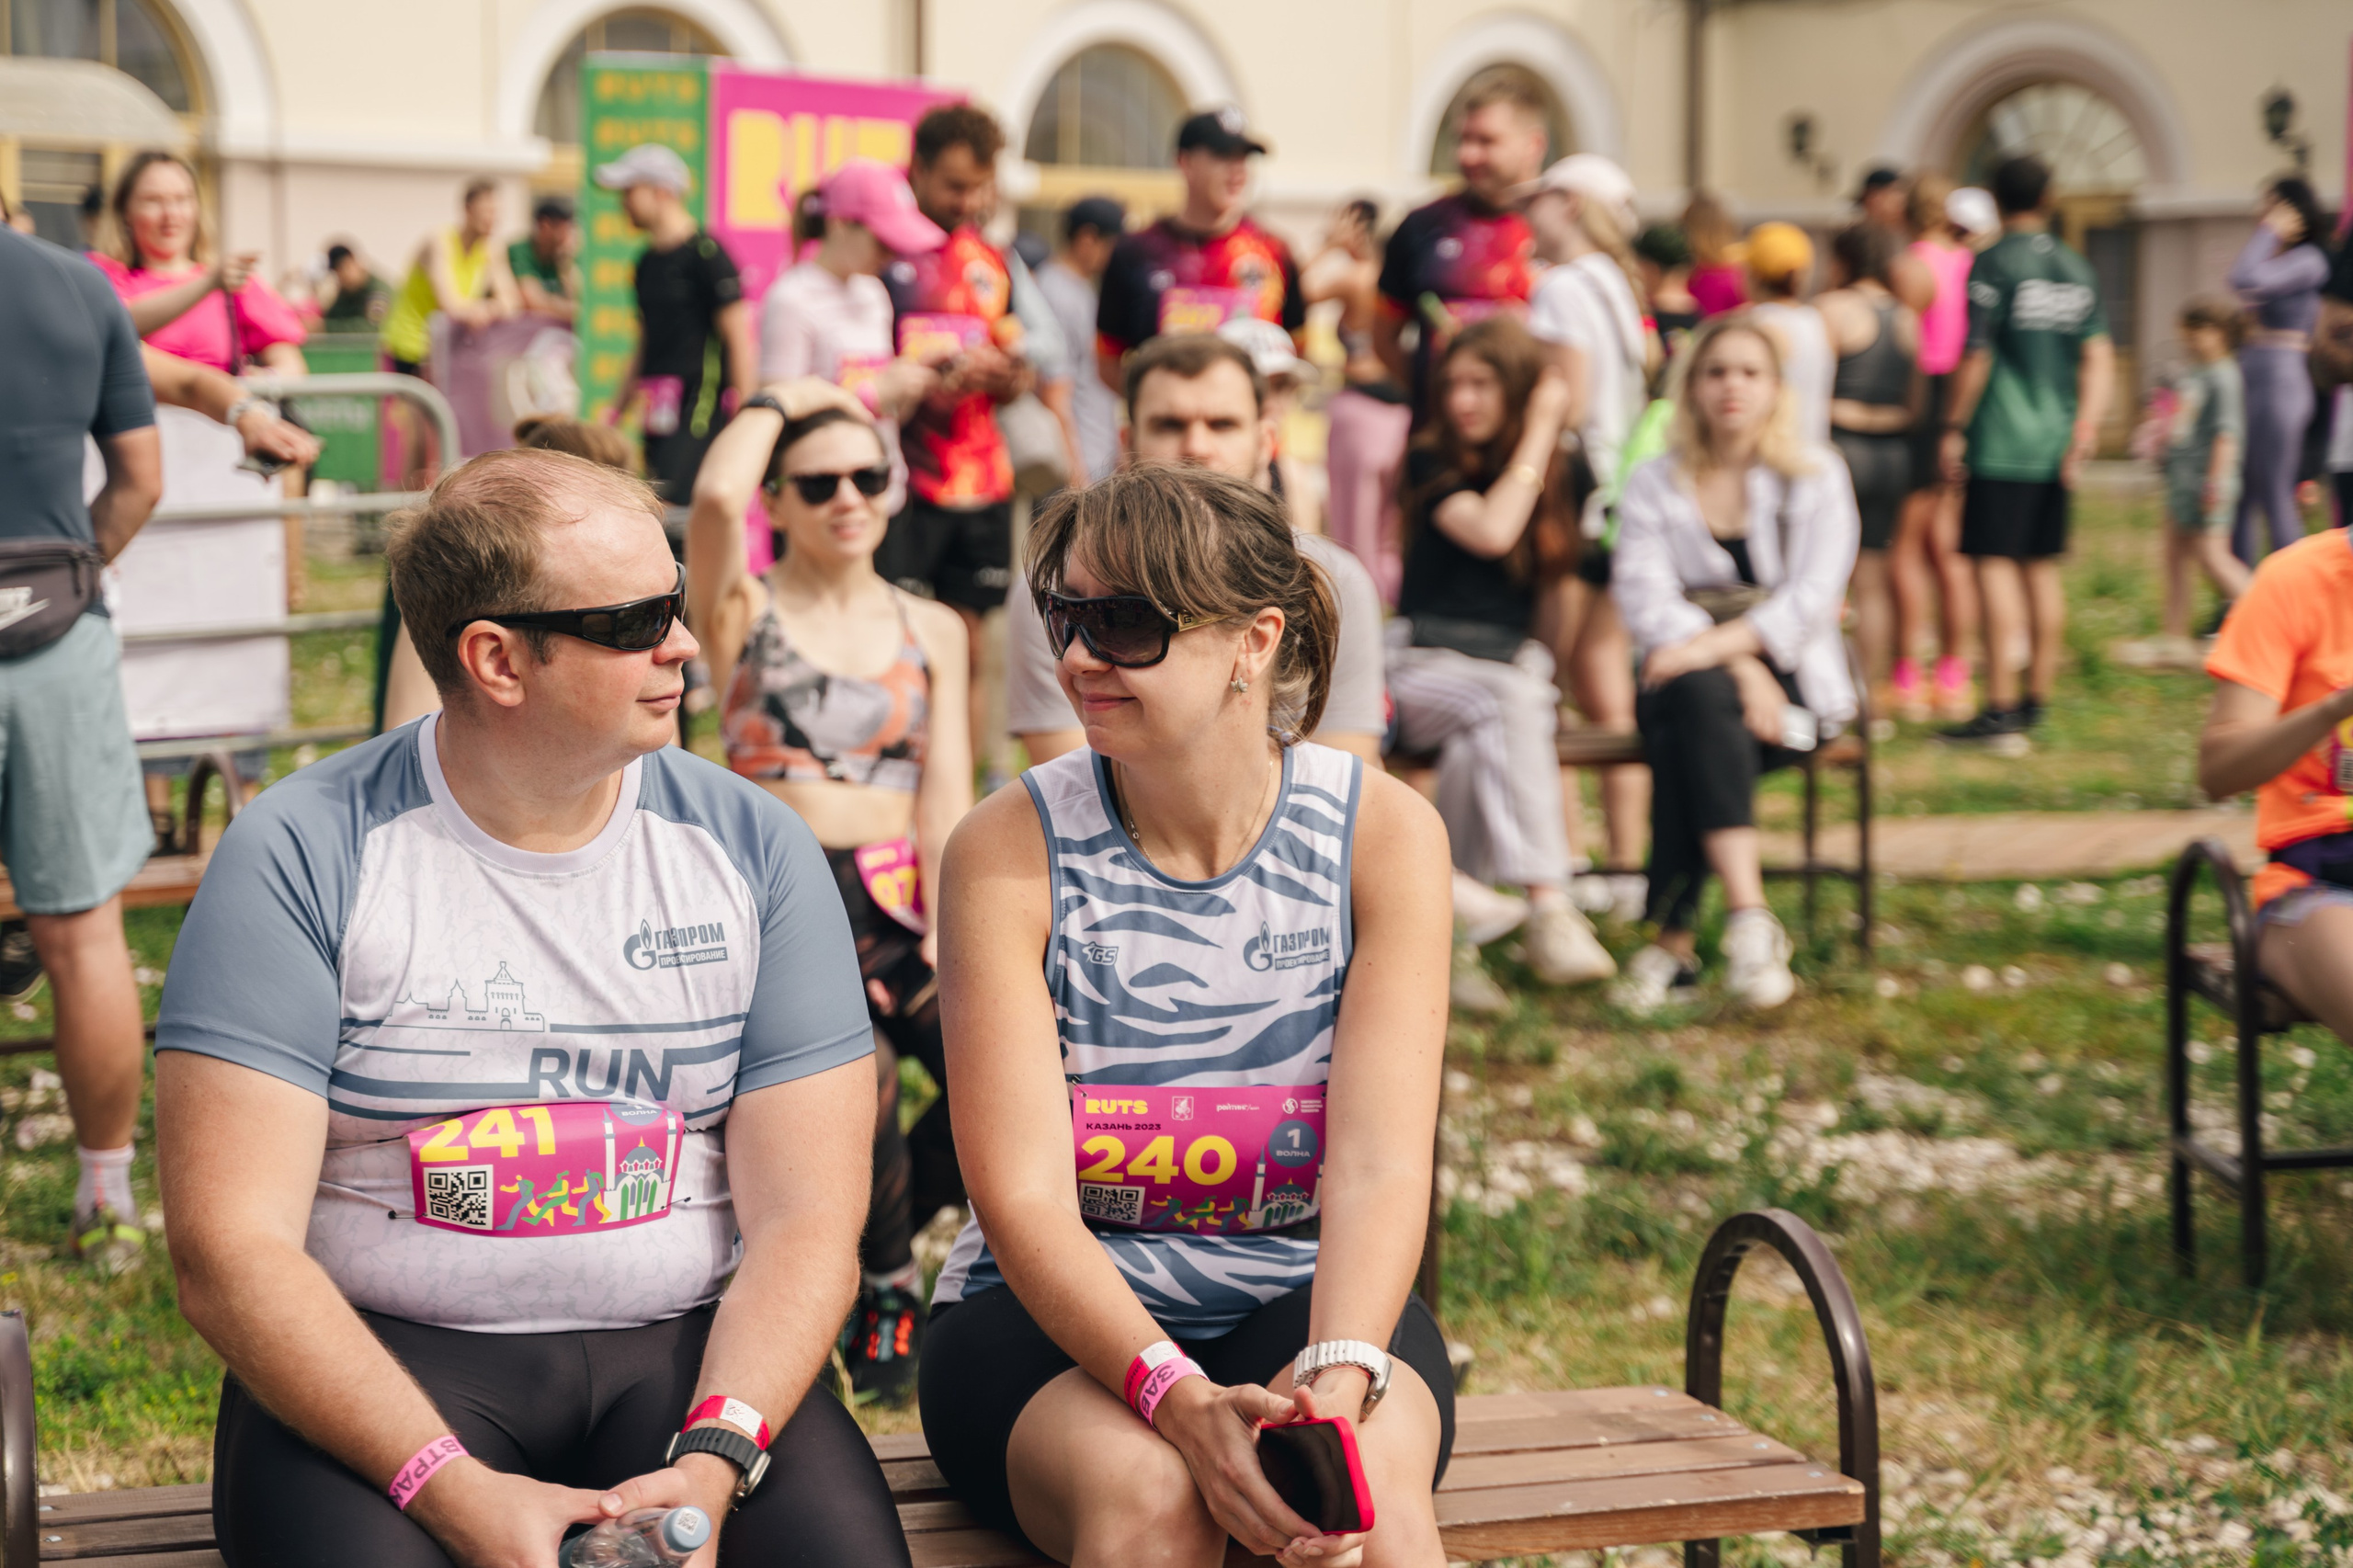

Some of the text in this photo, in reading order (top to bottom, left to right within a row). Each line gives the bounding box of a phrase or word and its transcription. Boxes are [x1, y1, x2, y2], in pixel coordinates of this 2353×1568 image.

[654, 922, 725, 950] ГАЗПРОМ
[529, 1048, 674, 1102] RUN
[1086, 1099, 1148, 1115] RUTS
[419, 1107, 556, 1163] 241
[1086, 1123, 1132, 1131] КАЗАНЬ
[1288, 1129, 1302, 1149] 1
[1078, 1134, 1238, 1186] 240
